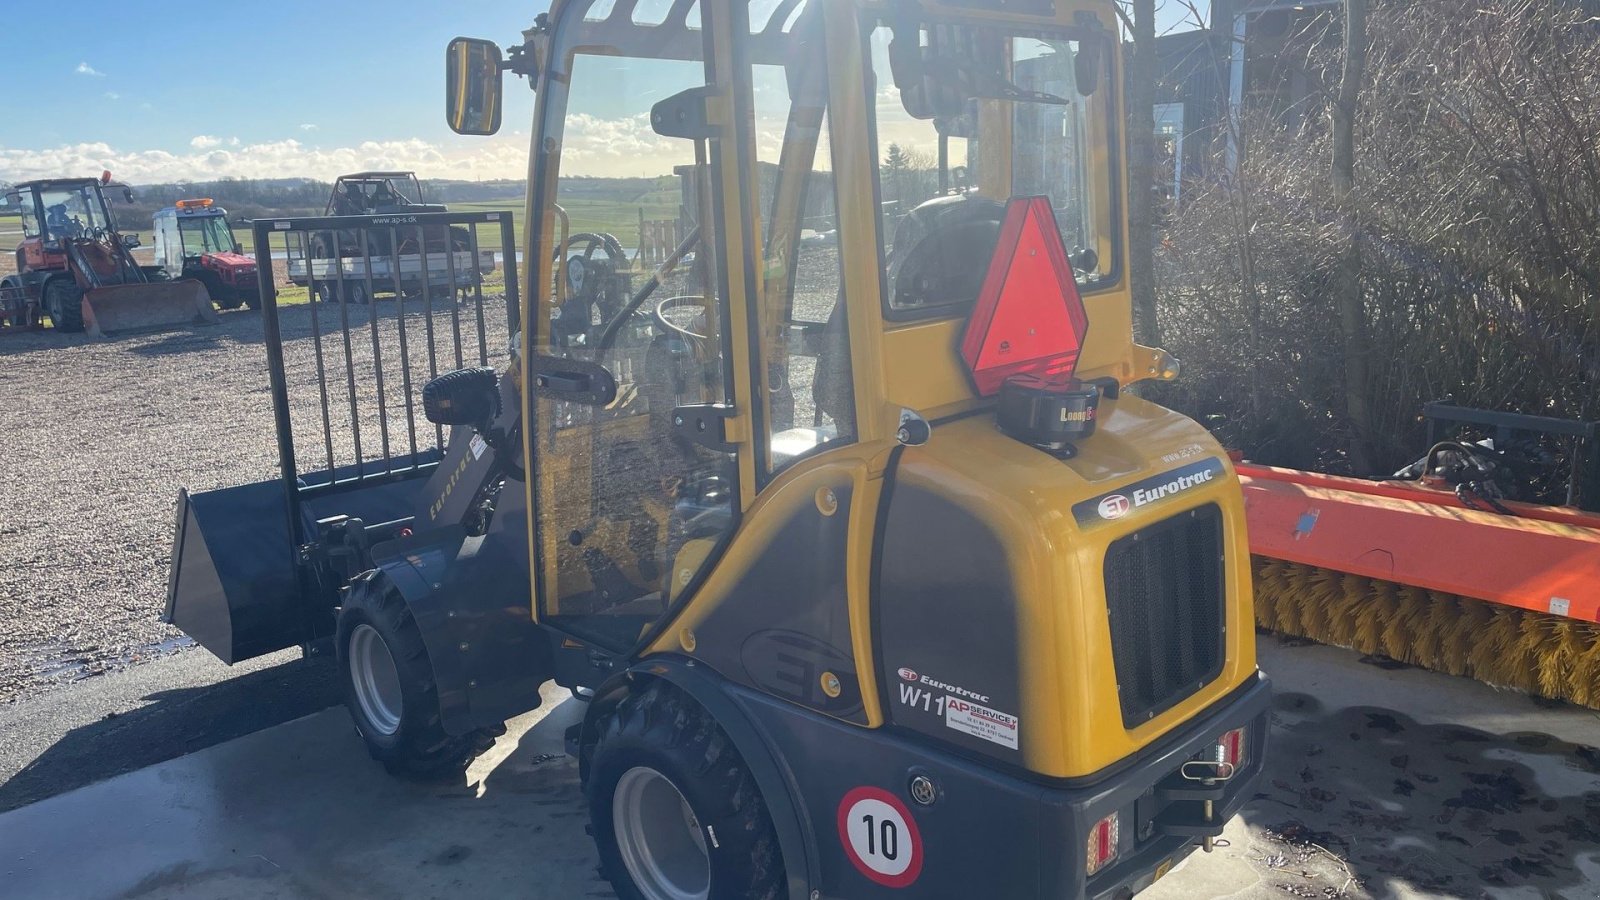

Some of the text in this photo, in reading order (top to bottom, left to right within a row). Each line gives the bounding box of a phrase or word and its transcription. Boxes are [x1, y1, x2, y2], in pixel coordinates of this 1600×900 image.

[429, 449, 472, 521] Eurotrac
[1133, 468, 1213, 507] Eurotrac
[899, 682, 945, 717] W11
[920, 675, 990, 703] Eurotrac
[948, 699, 970, 712] AP
[970, 705, 1011, 723] SERVICE
[862, 814, 898, 861] 10
